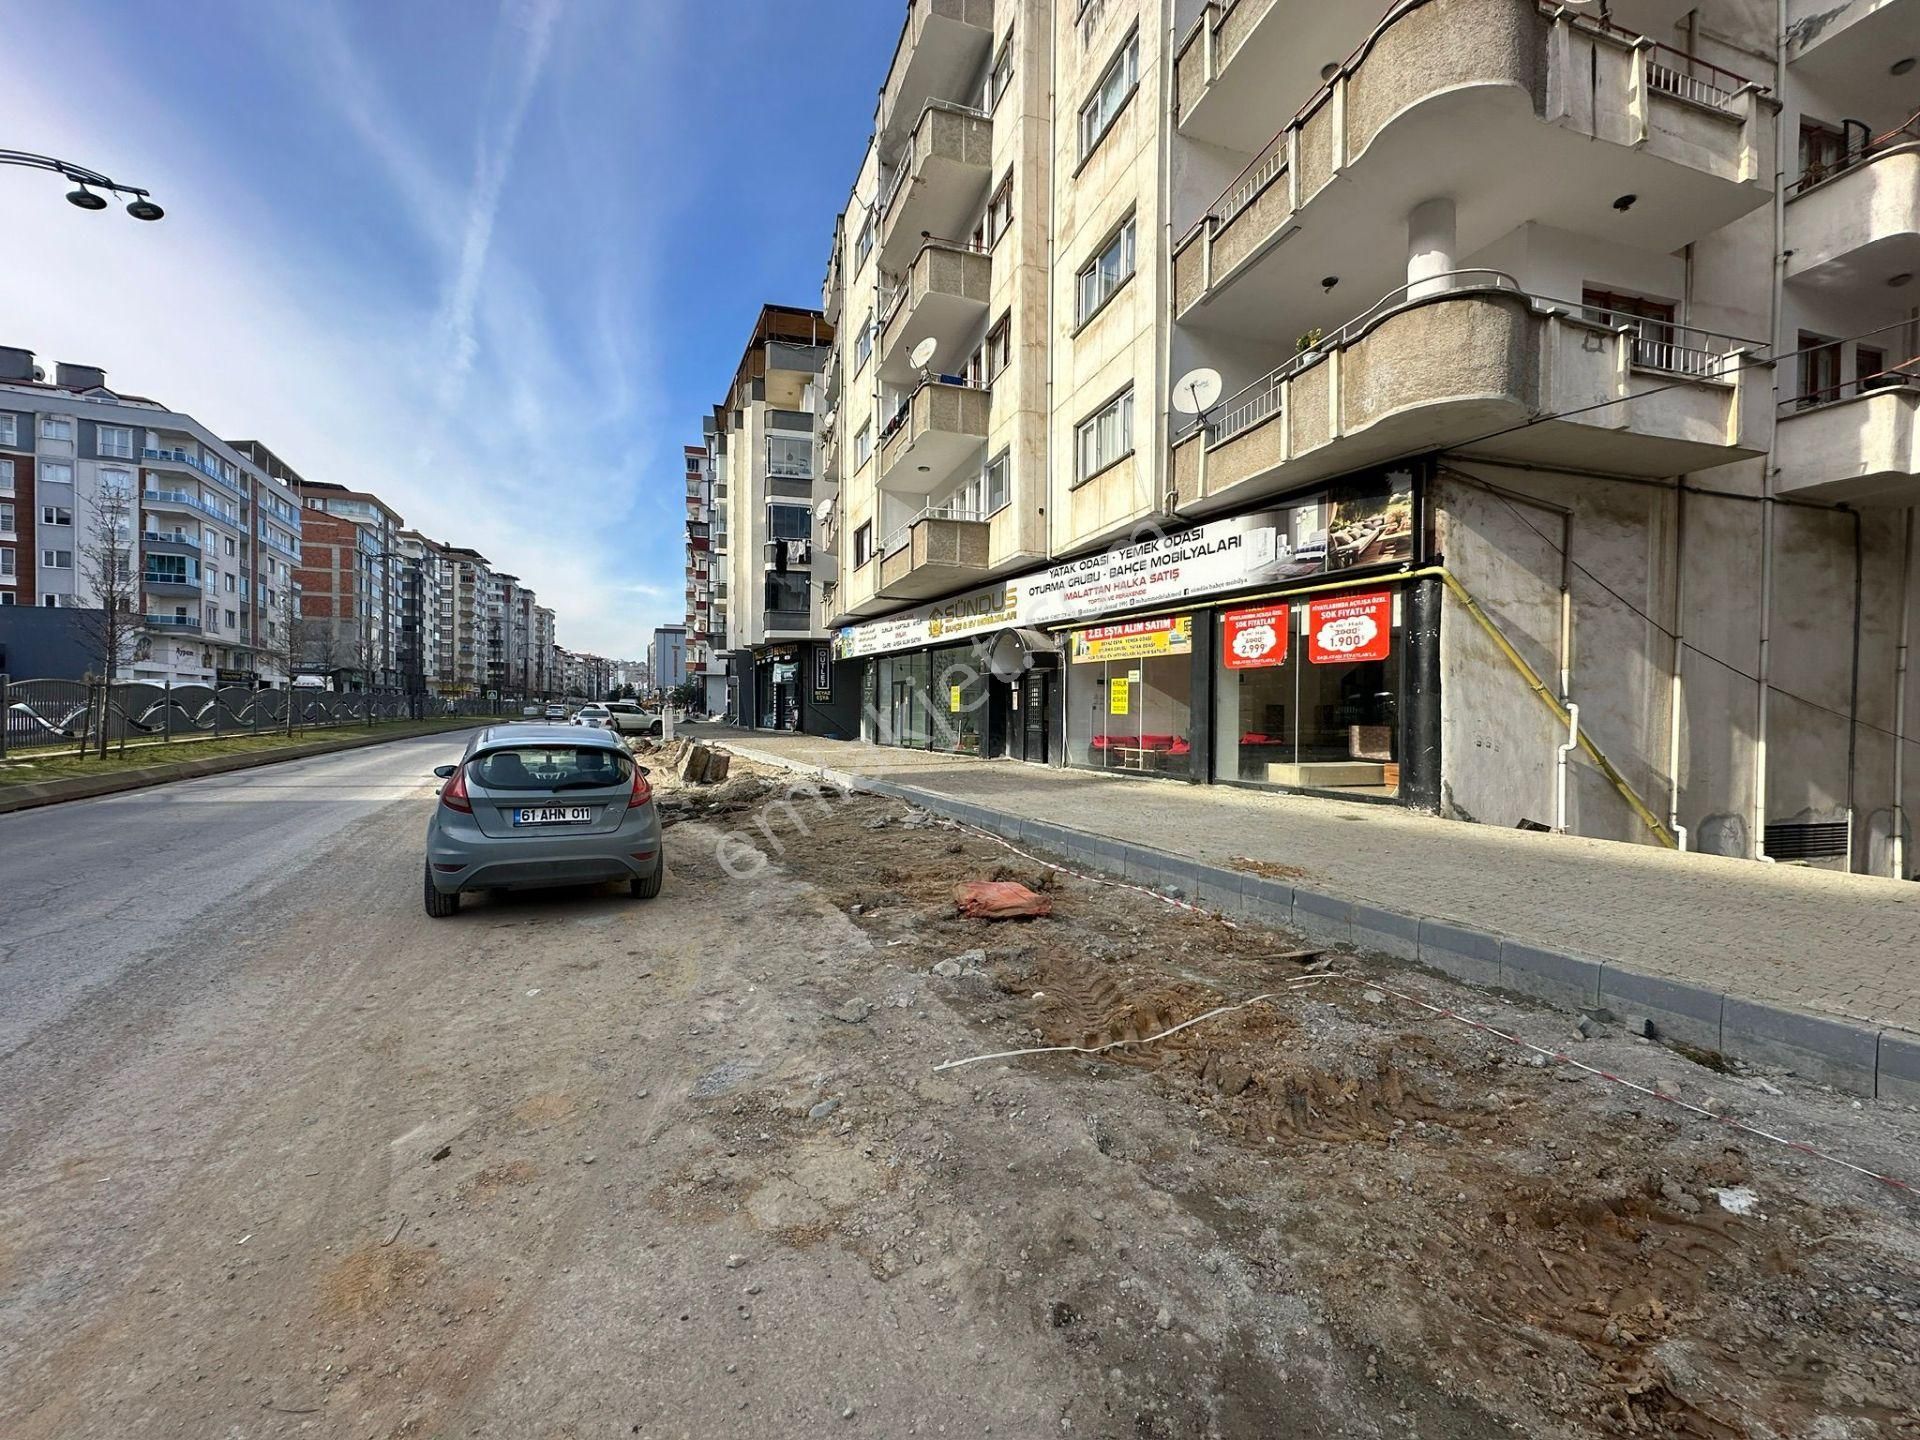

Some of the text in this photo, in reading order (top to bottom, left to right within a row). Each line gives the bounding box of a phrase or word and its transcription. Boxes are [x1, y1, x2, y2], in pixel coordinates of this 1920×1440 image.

[1049, 563, 1076, 579] YATAK
[1079, 556, 1110, 571] ODASI
[1119, 540, 1160, 561] YEMEK
[1164, 527, 1205, 549] ODASI
[1028, 581, 1065, 597] OTURMA
[1067, 570, 1101, 588] GRUBU
[1109, 560, 1147, 579] BAHÇE
[1150, 533, 1242, 571] MOBİLYALARI
[1113, 577, 1147, 593] HALKA
[1150, 567, 1180, 583] SATIŞ
[1248, 618, 1276, 627] FİYATLAR
[1320, 606, 1376, 620] ŞOK FİYATLAR
[1088, 628, 1103, 639] 2.EL
[1124, 622, 1144, 634] ALIM
[1145, 619, 1171, 632] SATIM
[522, 808, 590, 821] 61 AHN 011
